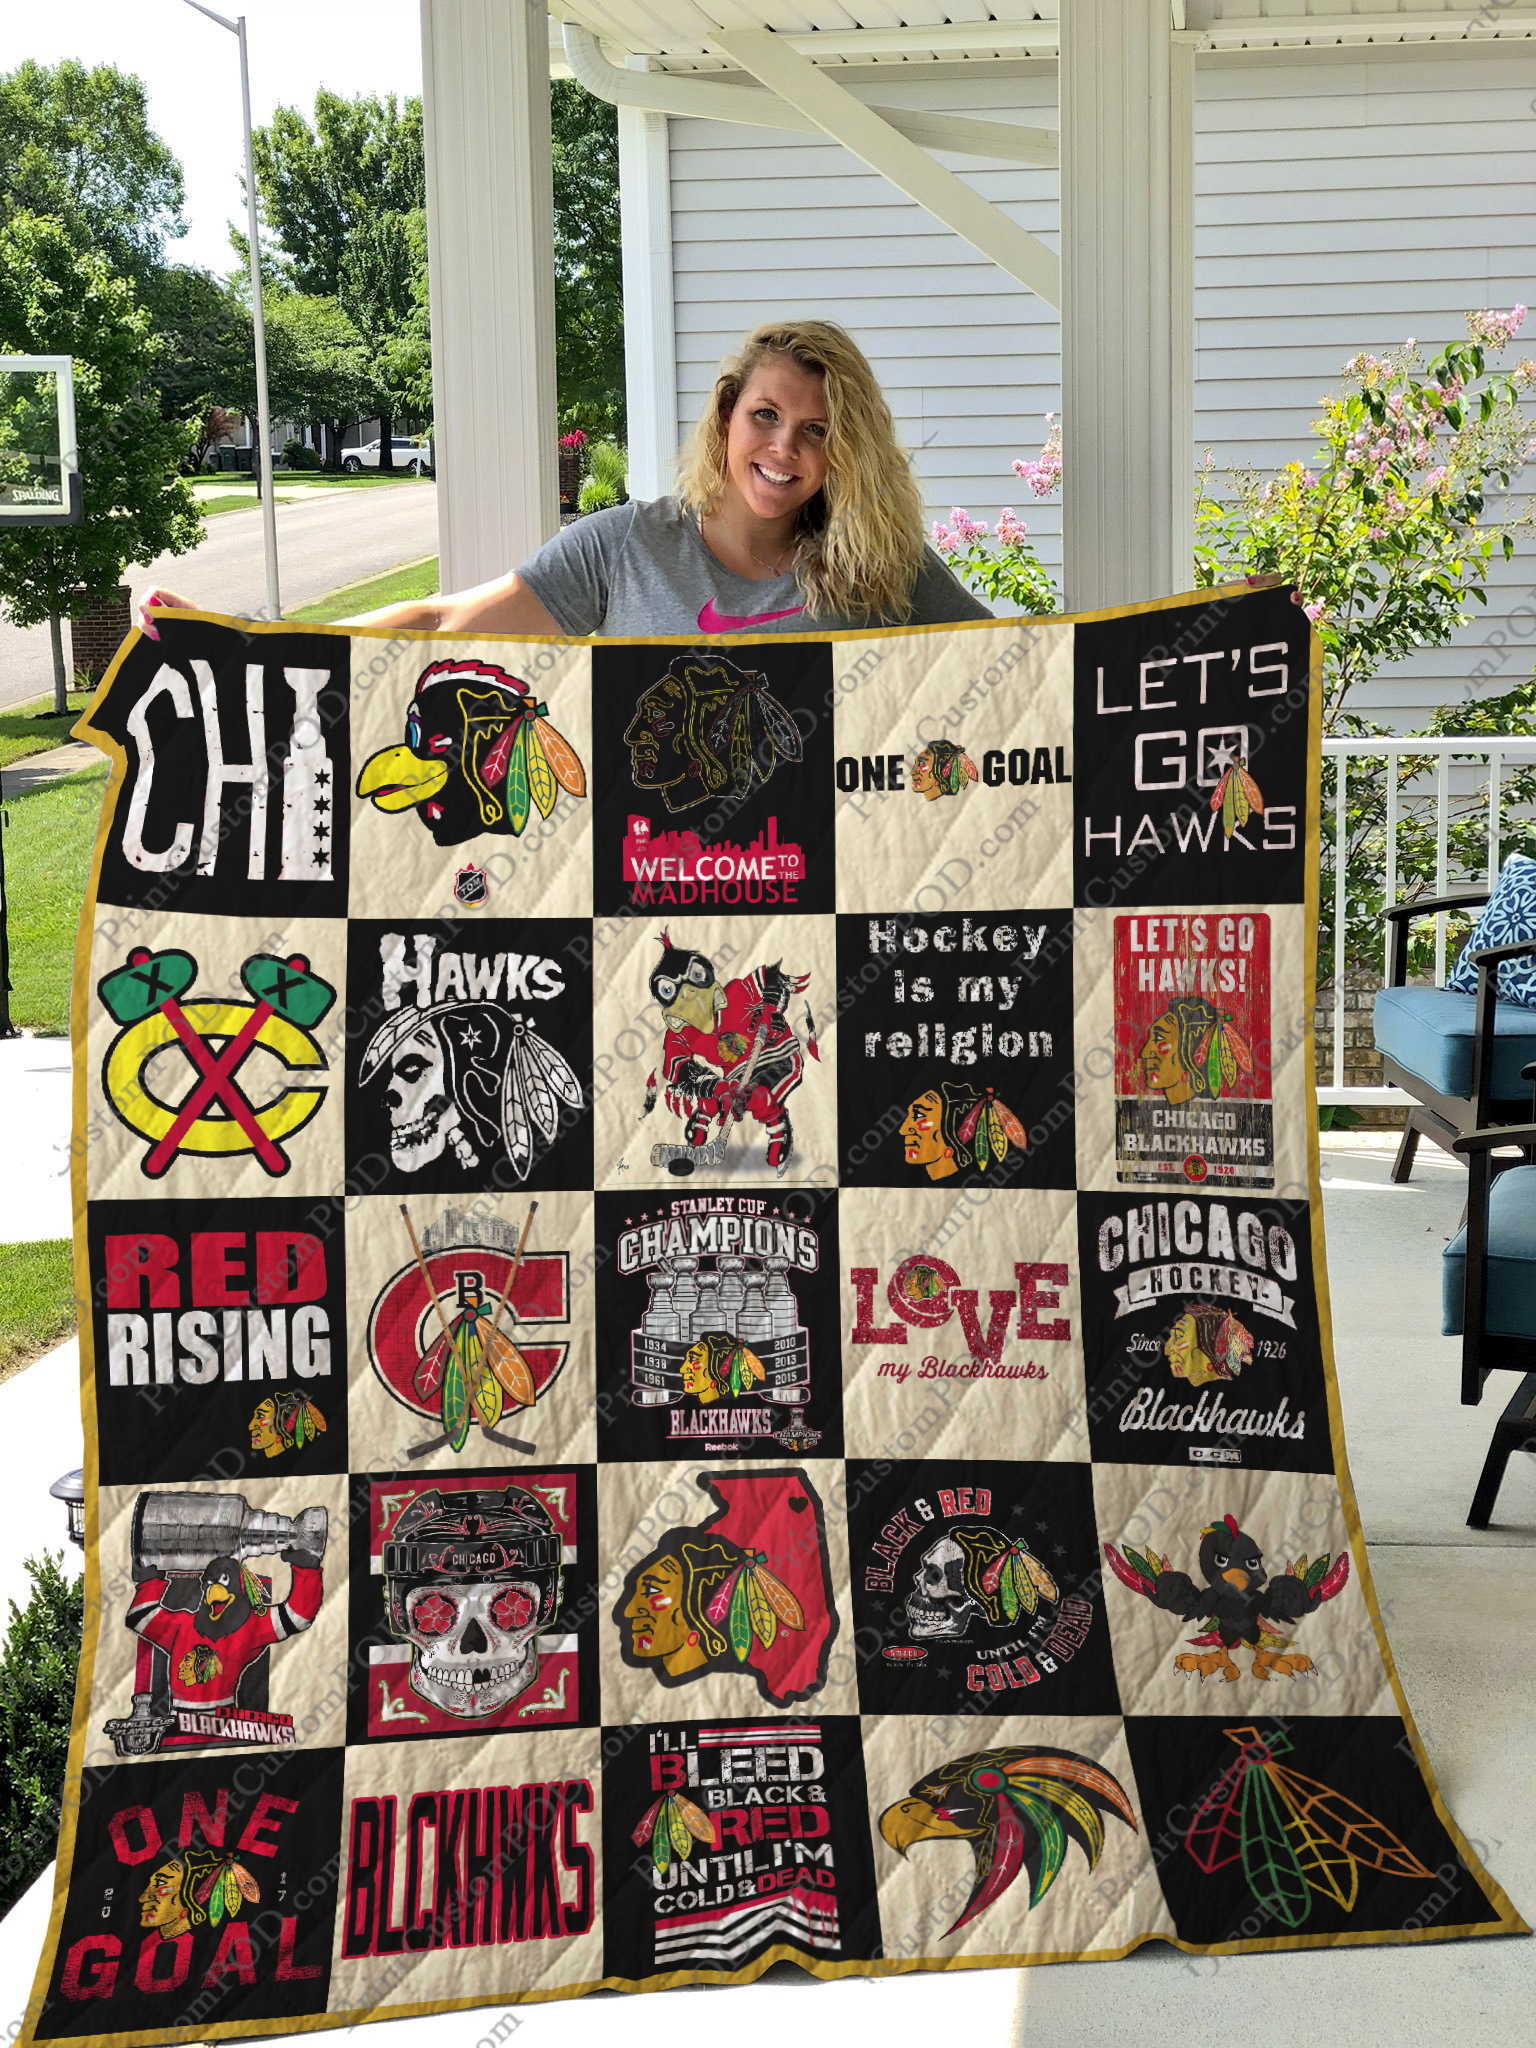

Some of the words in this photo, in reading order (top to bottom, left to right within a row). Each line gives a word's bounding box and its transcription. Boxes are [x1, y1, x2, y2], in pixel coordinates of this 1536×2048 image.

[12, 490, 61, 502] SPALDING
[1096, 641, 1289, 716] LET'S
[836, 755, 906, 793] ONE
[982, 746, 1073, 788] GOAL
[1134, 724, 1249, 791] GO
[630, 856, 777, 881] WELCOME
[778, 854, 799, 867] TO
[778, 871, 799, 880] THE
[631, 879, 799, 905] MADHOUSE
[867, 917, 1047, 960] Hockey
[1130, 917, 1206, 953] LET'S
[1218, 916, 1255, 952] GO
[379, 933, 566, 1011] HAWKS
[894, 969, 935, 1004] is
[957, 969, 1023, 1011] my
[1138, 958, 1247, 993] HAWKS!
[864, 1023, 1054, 1066] religion
[1153, 1109, 1237, 1130] CHICAGO
[1124, 1134, 1266, 1156] BLACKHAWKS
[1157, 1163, 1175, 1172] EST.
[1213, 1165, 1235, 1175] 1926
[671, 1197, 735, 1216] STANLEY
[738, 1200, 767, 1215] CUP
[618, 1213, 820, 1275] CHAMPIONS
[1099, 1200, 1298, 1281] CHICAGO
[104, 1231, 328, 1309] RED
[850, 1254, 1071, 1363] LOVE
[107, 1306, 332, 1387] RISING
[644, 1338, 667, 1352] 1934
[774, 1337, 796, 1350] 2010
[644, 1355, 667, 1369] 1938
[774, 1354, 797, 1368] 2013
[1126, 1333, 1162, 1353] Since
[1256, 1340, 1287, 1359] 1926
[644, 1372, 665, 1386] 1961
[775, 1371, 797, 1385] 2015
[877, 1360, 913, 1383] my
[917, 1355, 1049, 1382] Blackhawks
[670, 1408, 772, 1436] BLACKHAWKS
[1119, 1387, 1306, 1440] Blackhawks
[705, 1442, 739, 1452] Reebok
[1191, 1449, 1241, 1462] CCM
[865, 1508, 924, 1592] BLACK
[914, 1498, 935, 1521] &
[937, 1487, 991, 1517] RED
[452, 1553, 496, 1565] CHICAGO
[976, 1639, 1029, 1660] UNTIL
[1028, 1614, 1047, 1639] I'M
[1042, 1598, 1094, 1662] DEAD
[967, 1656, 1041, 1691] COLD
[1035, 1651, 1058, 1673] &
[178, 1712, 296, 1744] BLACKHAWKS
[216, 1706, 293, 1726] CHICAGO
[650, 1730, 697, 1753] I'LL
[650, 1746, 825, 1791] BLEED
[708, 1785, 806, 1809] BLACK
[107, 1788, 300, 1867] ONE
[709, 1805, 831, 1851] RED
[341, 1779, 594, 1960] BLCKHWKS
[653, 1849, 770, 1890] UNTIL
[773, 1839, 835, 1868] I'M
[60, 1917, 323, 2001] GOAL
